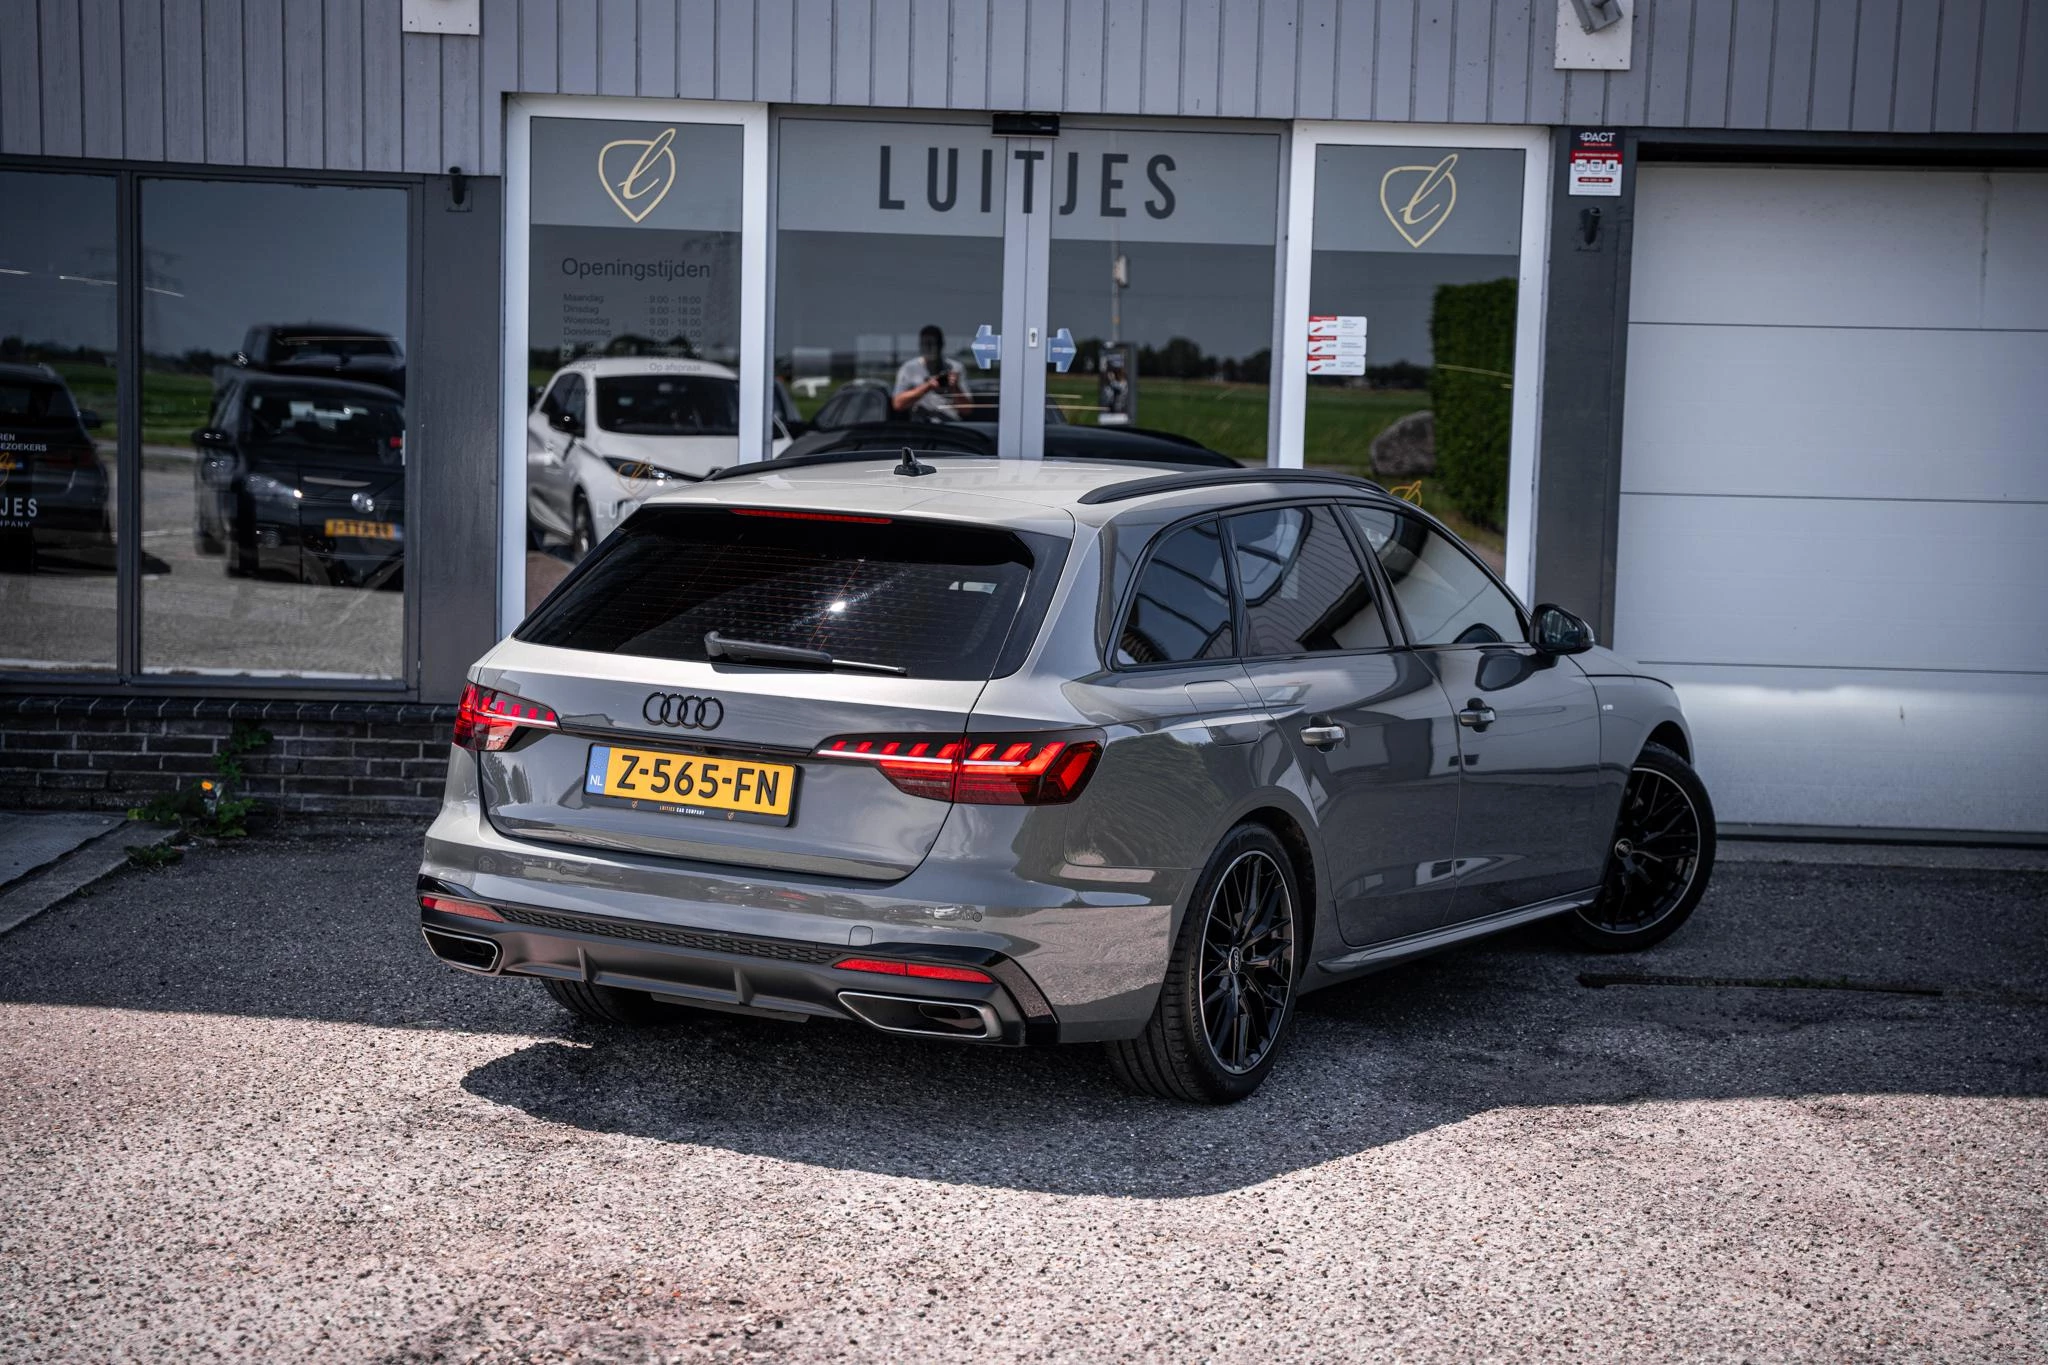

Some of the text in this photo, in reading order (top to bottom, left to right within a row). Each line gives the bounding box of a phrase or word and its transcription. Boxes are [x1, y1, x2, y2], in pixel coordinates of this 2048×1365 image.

[879, 145, 1177, 220] LUITJES
[561, 257, 711, 282] Openingstijden
[563, 293, 604, 304] Maandag
[563, 304, 599, 315] Dinsdag
[563, 316, 610, 327] Woensdag
[563, 327, 612, 338] Donderdag
[589, 754, 780, 807] NL Z-565-FN
